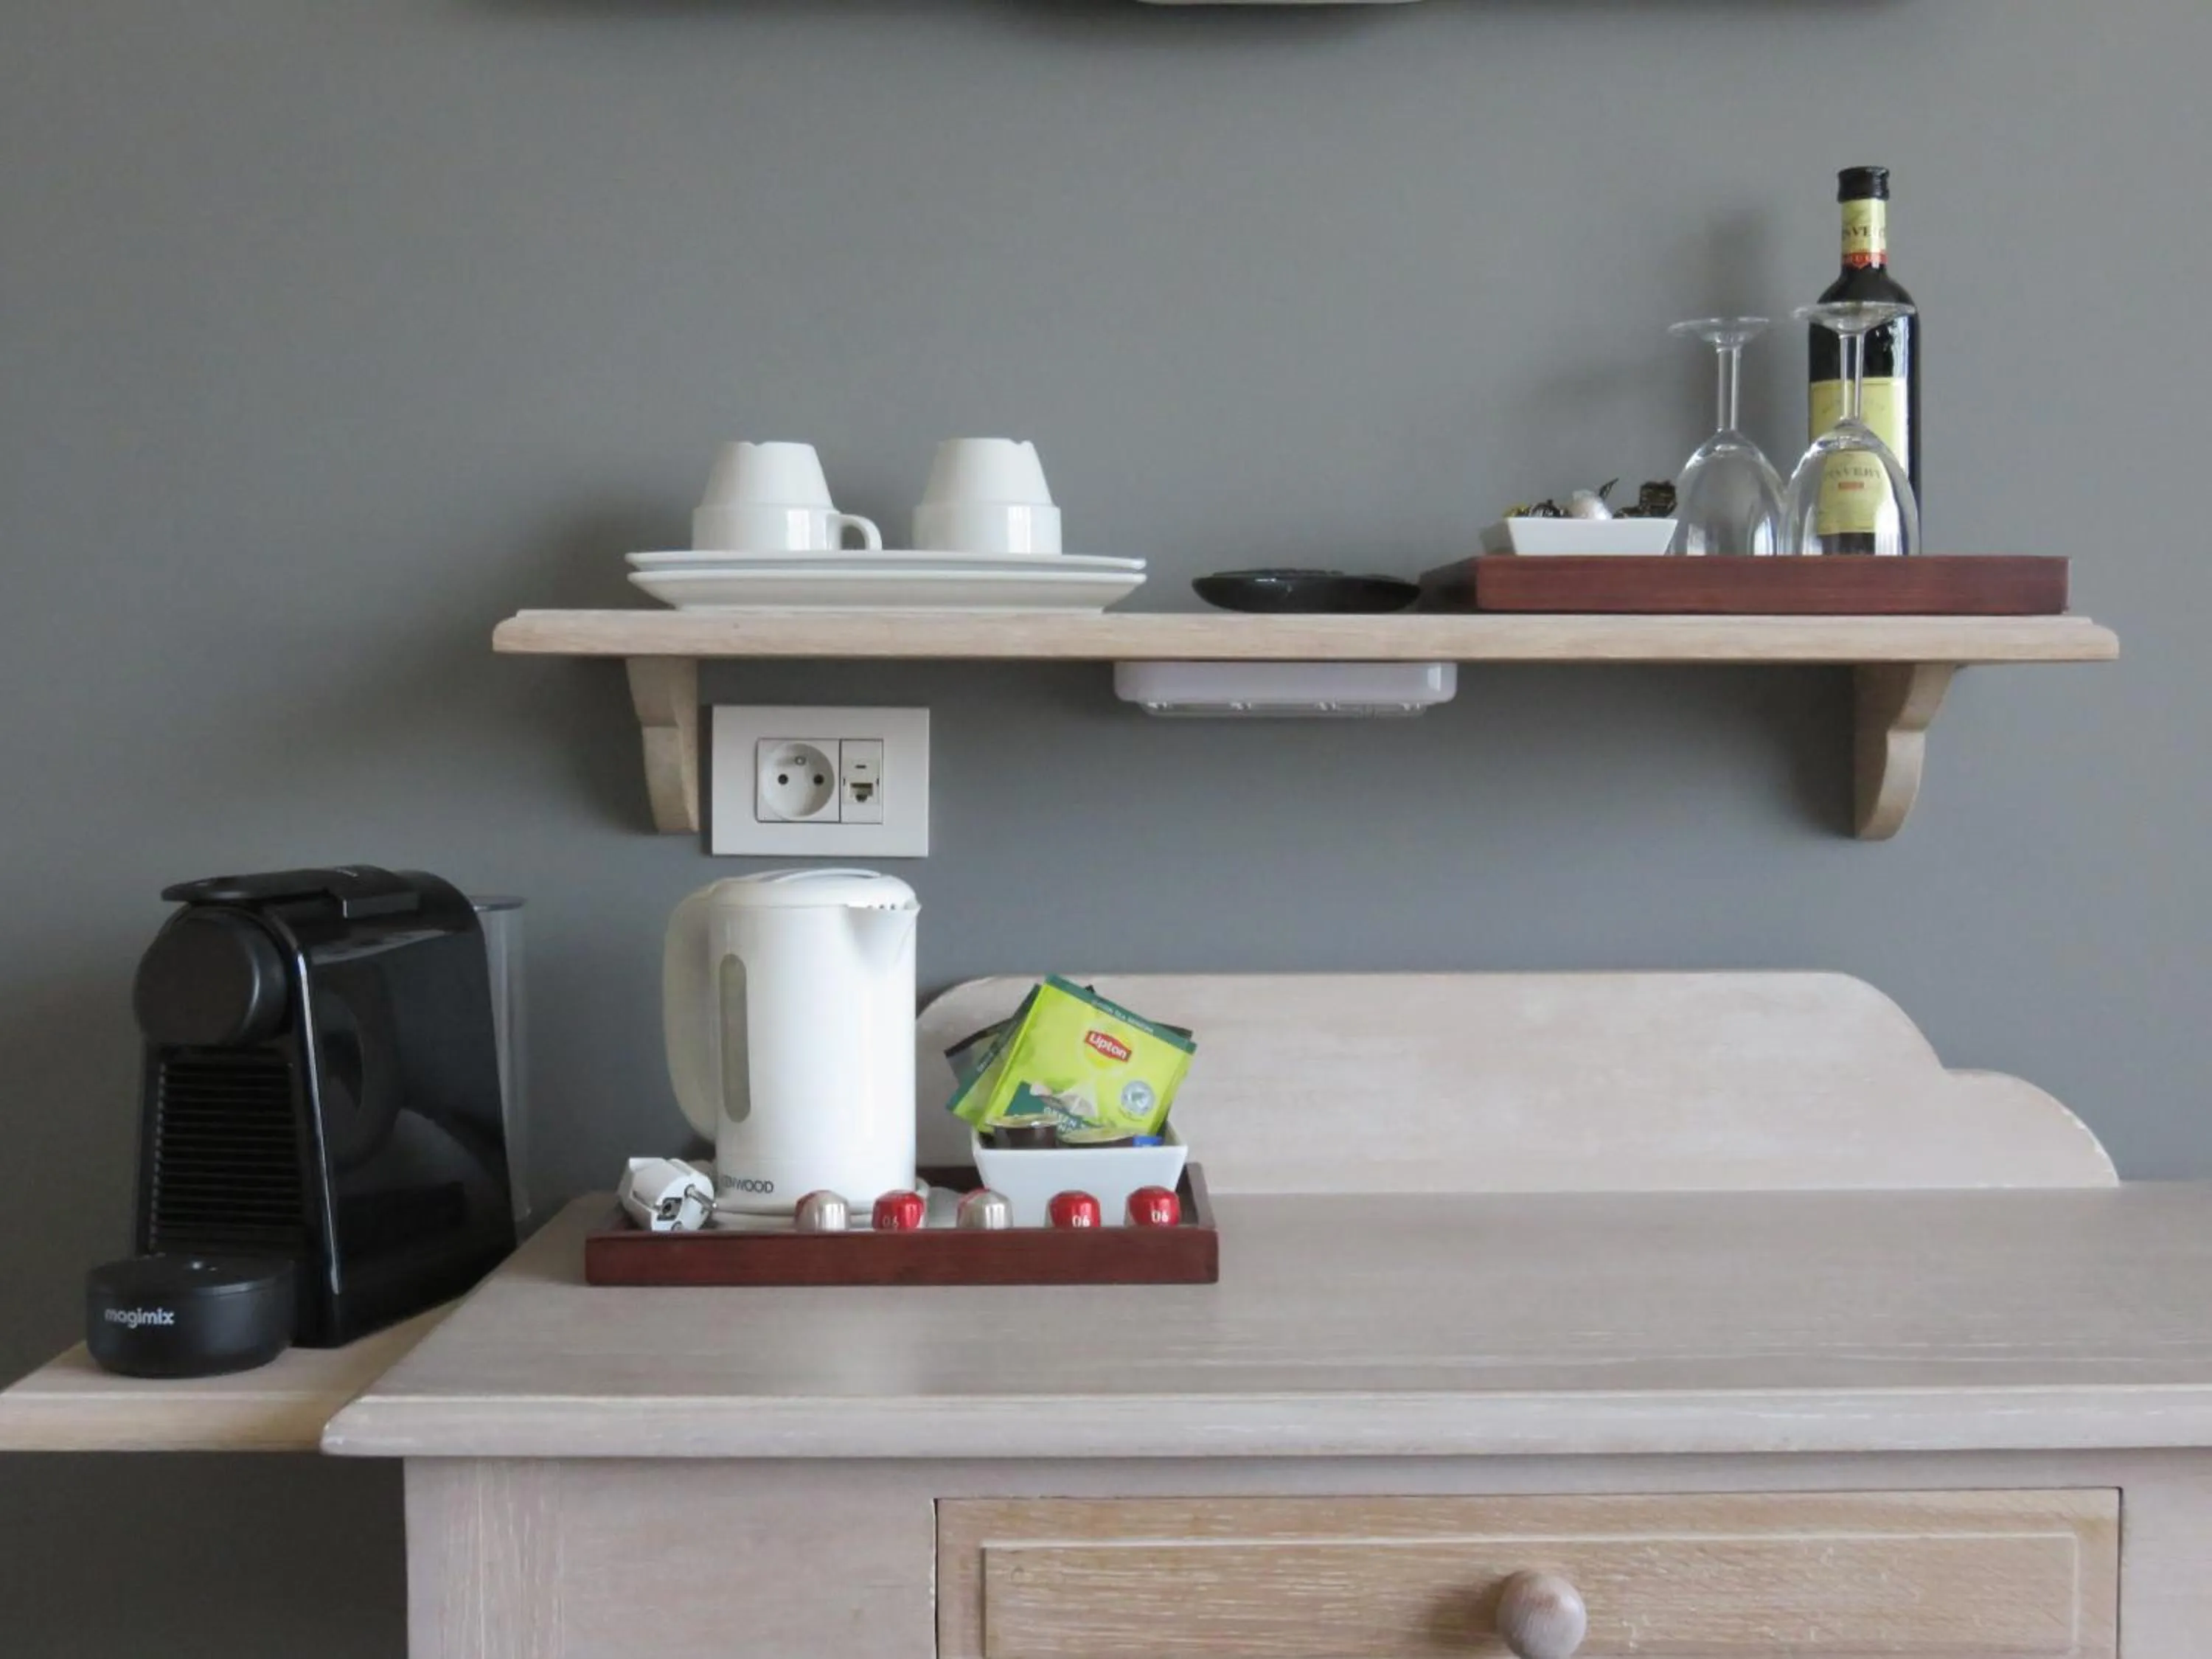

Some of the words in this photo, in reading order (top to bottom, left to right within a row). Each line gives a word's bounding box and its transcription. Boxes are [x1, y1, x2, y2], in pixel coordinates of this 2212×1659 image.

[1088, 1032, 1127, 1060] Lipton
[1071, 1214, 1091, 1228] 06
[1150, 1209, 1169, 1223] 06
[105, 1307, 175, 1329] magimix
